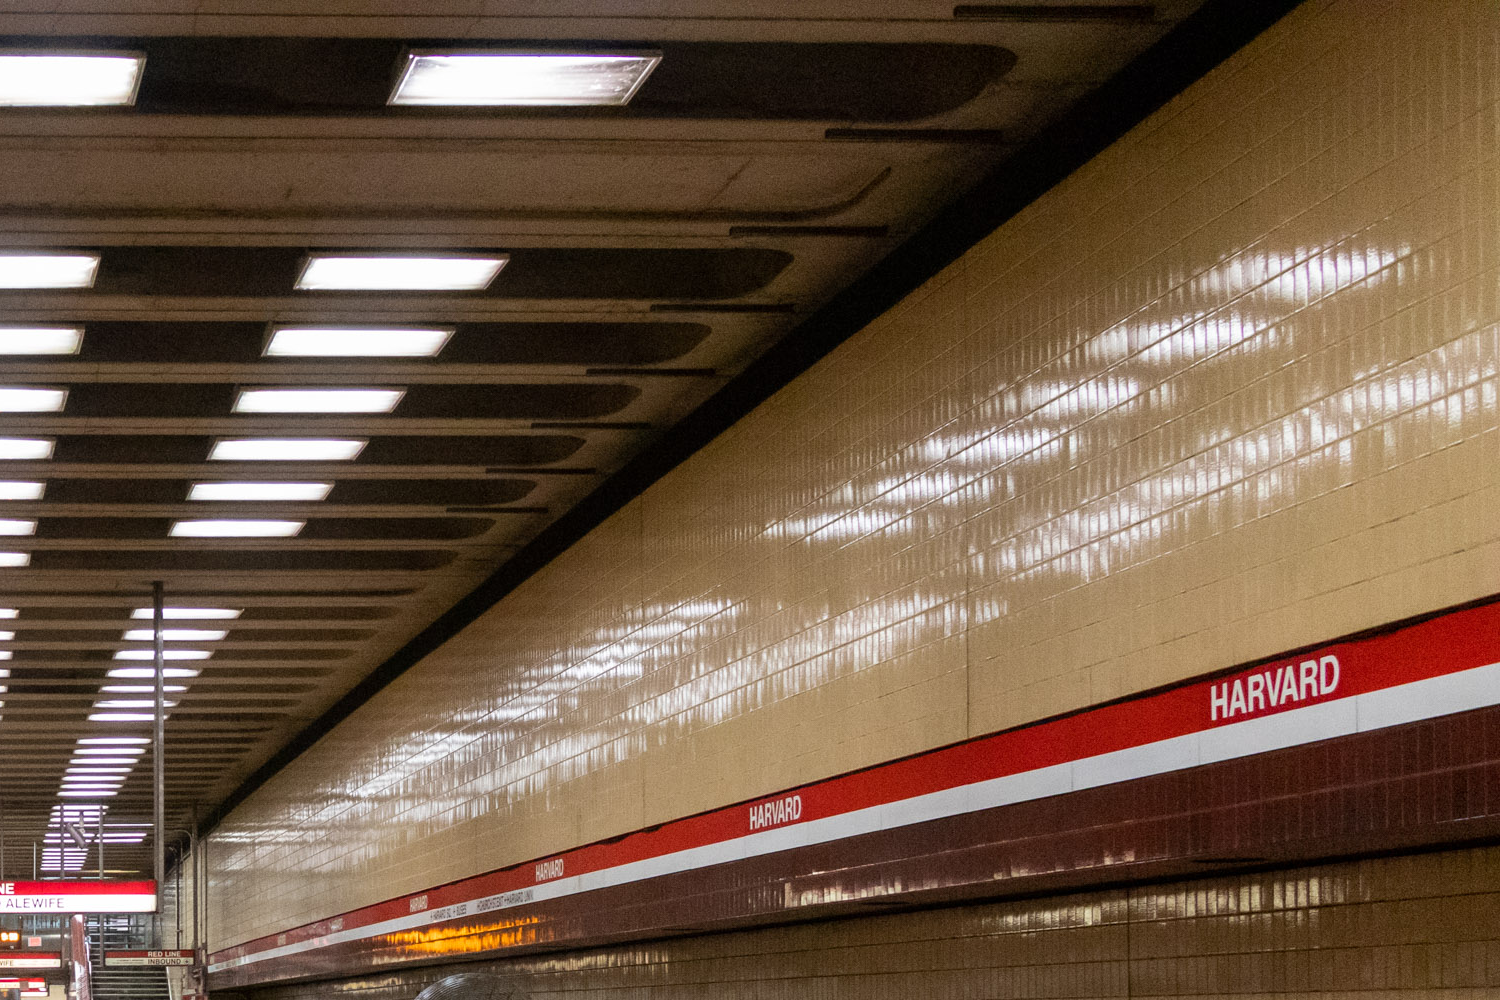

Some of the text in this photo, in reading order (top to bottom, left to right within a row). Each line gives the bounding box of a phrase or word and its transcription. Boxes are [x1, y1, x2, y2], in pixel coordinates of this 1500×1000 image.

[1211, 655, 1339, 721] HARVARD
[749, 795, 802, 830] HARVARD
[535, 858, 564, 882] HARVARD
[5, 897, 65, 909] ALEWIFE
